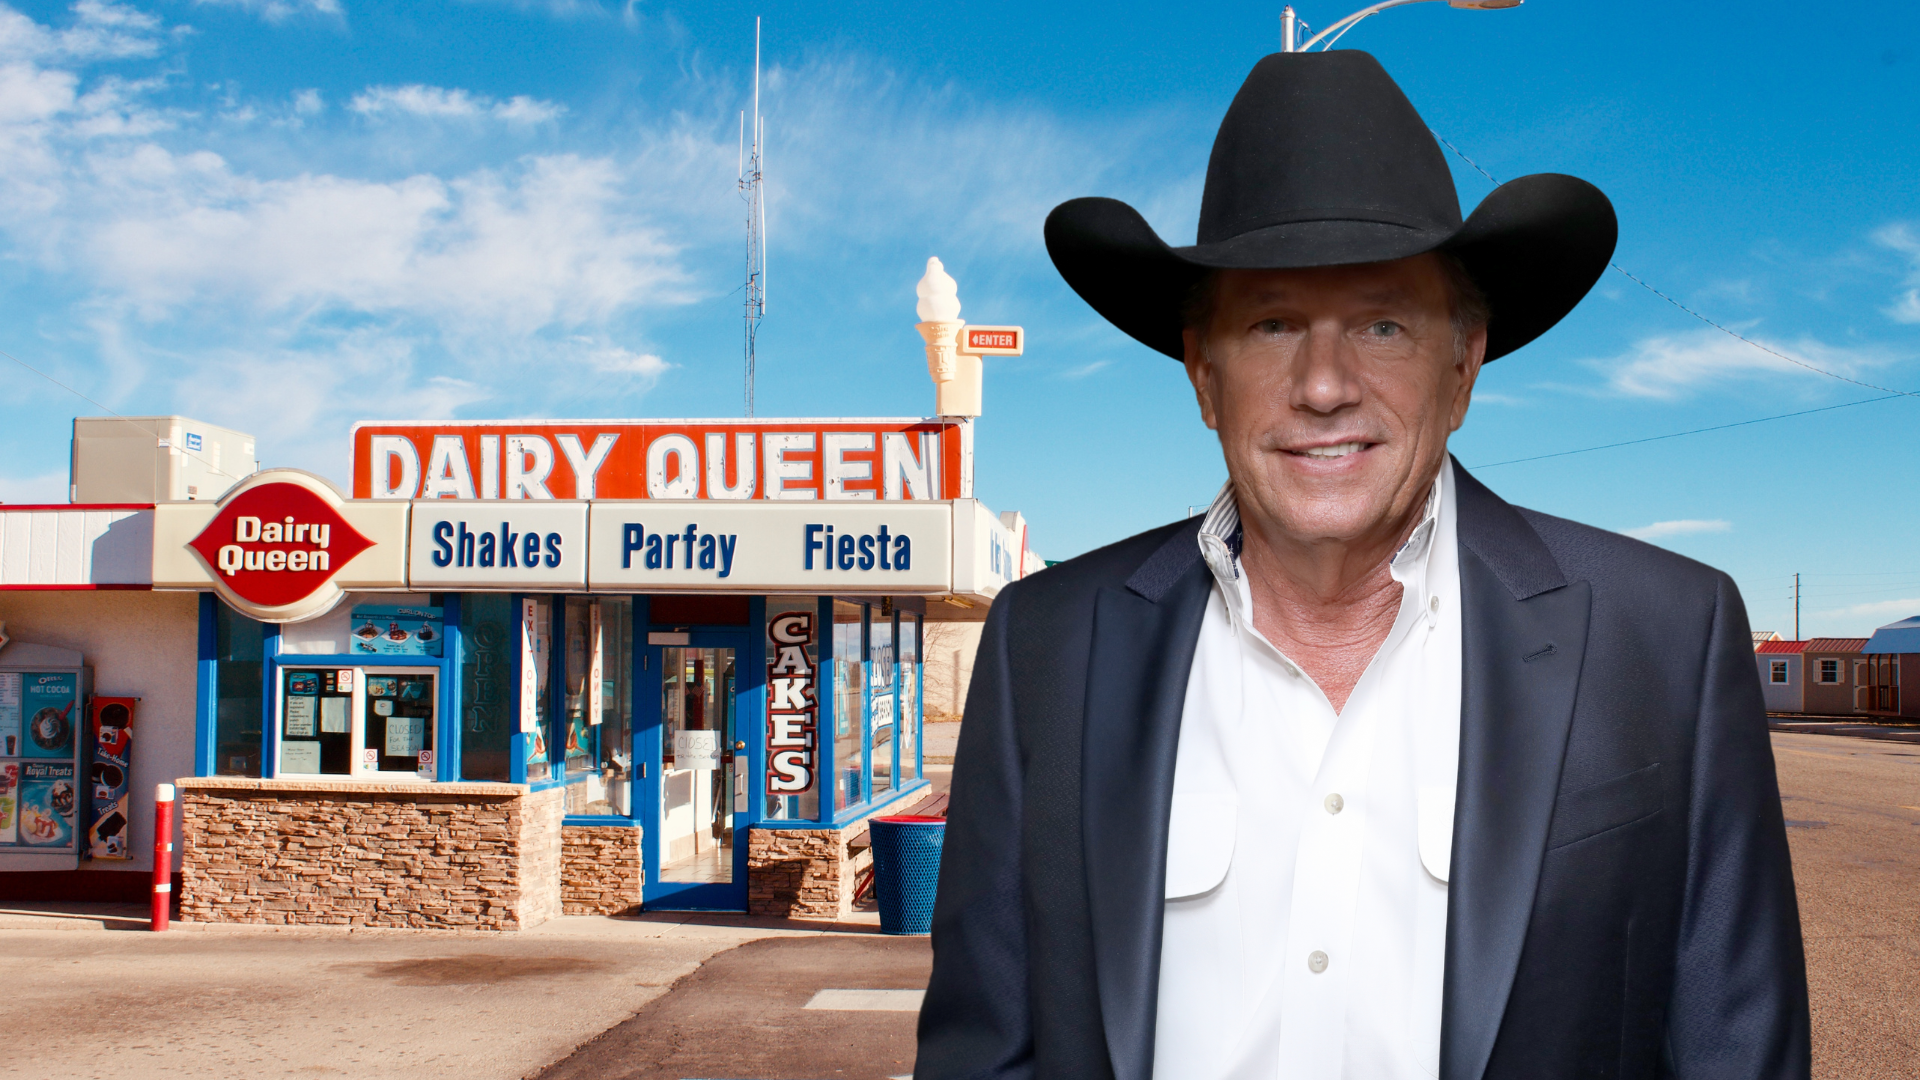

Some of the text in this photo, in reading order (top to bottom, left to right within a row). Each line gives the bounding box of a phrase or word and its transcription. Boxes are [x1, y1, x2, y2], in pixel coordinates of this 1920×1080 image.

[978, 334, 1013, 346] ENTER
[370, 432, 941, 500] DAIRY QUEEN
[236, 516, 331, 548] Dairy
[432, 519, 562, 568] Shakes
[218, 544, 331, 576] Queen
[622, 522, 911, 578] Parfay Fiesta
[526, 605, 534, 662] EXIT
[30, 685, 70, 694] HOT COCOA
[472, 621, 503, 733] OPEN
[525, 669, 533, 726] ONLY
[768, 611, 818, 795] CAKES
[389, 724, 422, 735] CLOSED
[25, 765, 73, 778] Royal Treats
[97, 747, 129, 768] Take-Home
[97, 801, 119, 816] Treats
